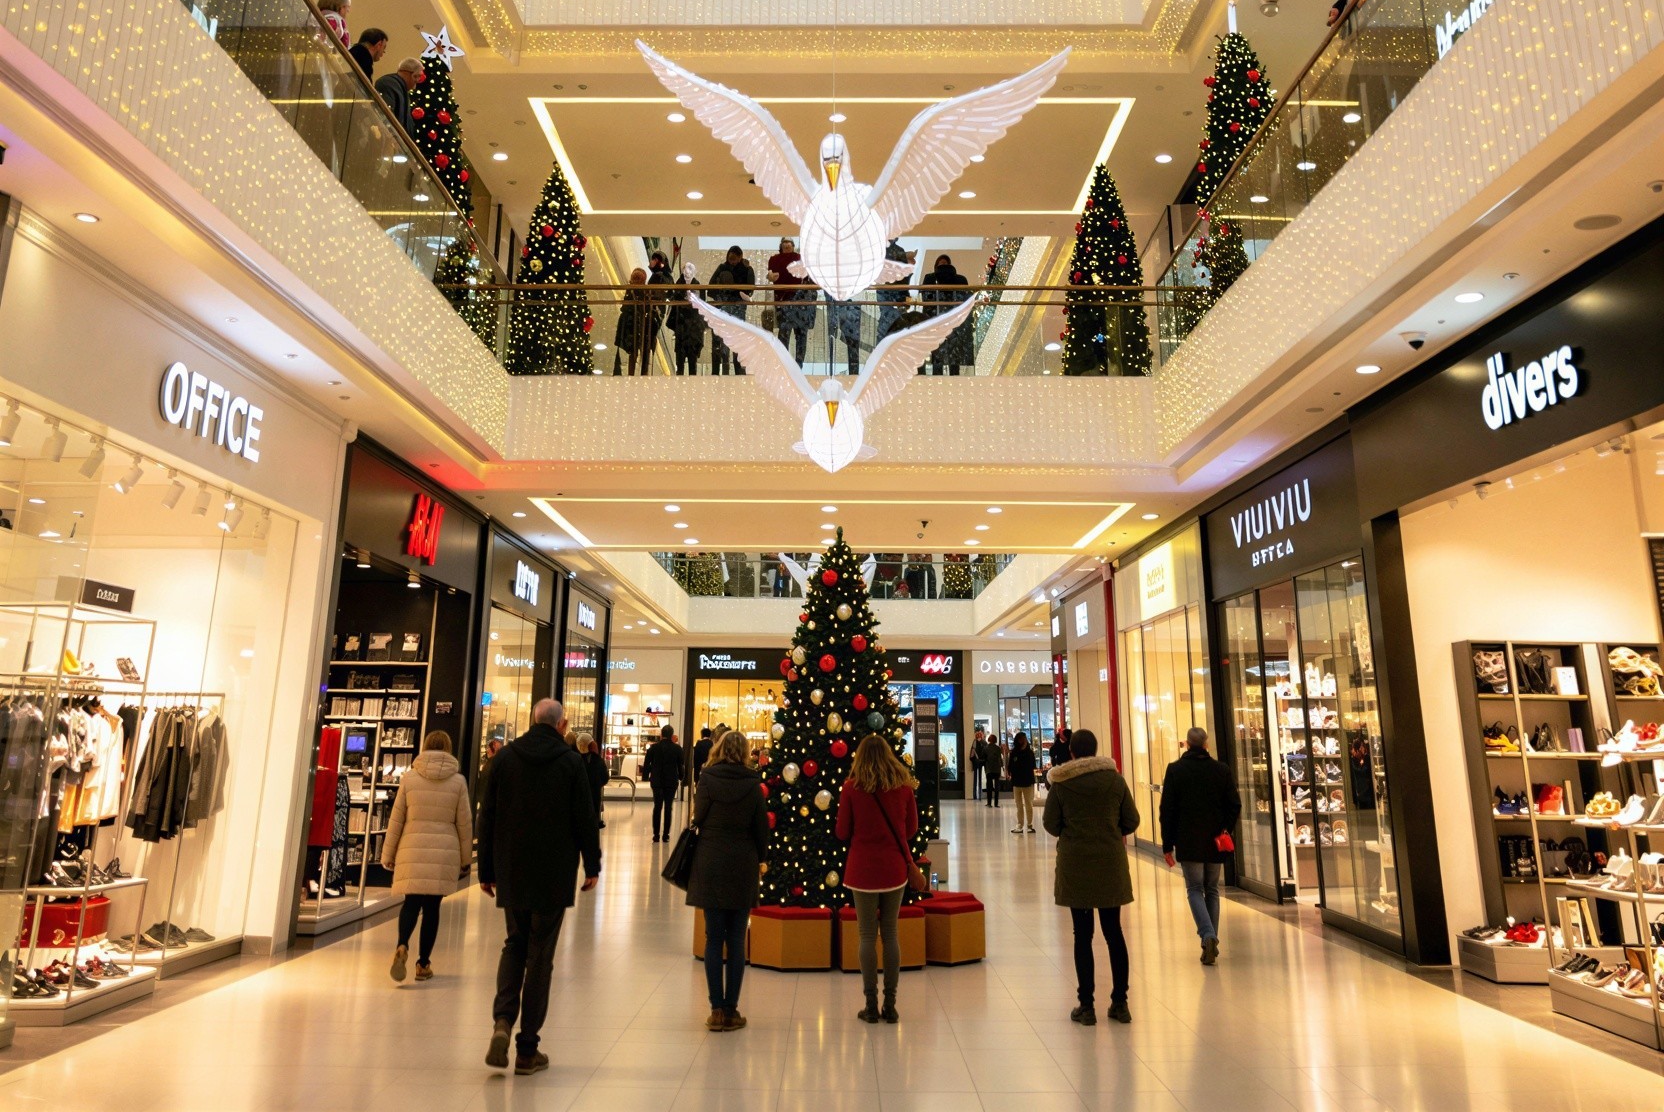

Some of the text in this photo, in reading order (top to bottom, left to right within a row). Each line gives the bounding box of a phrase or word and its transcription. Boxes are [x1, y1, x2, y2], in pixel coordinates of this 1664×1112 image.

[160, 361, 264, 464] OFFICE
[1482, 345, 1578, 430] divers
[1230, 478, 1311, 549] VIUIVIU
